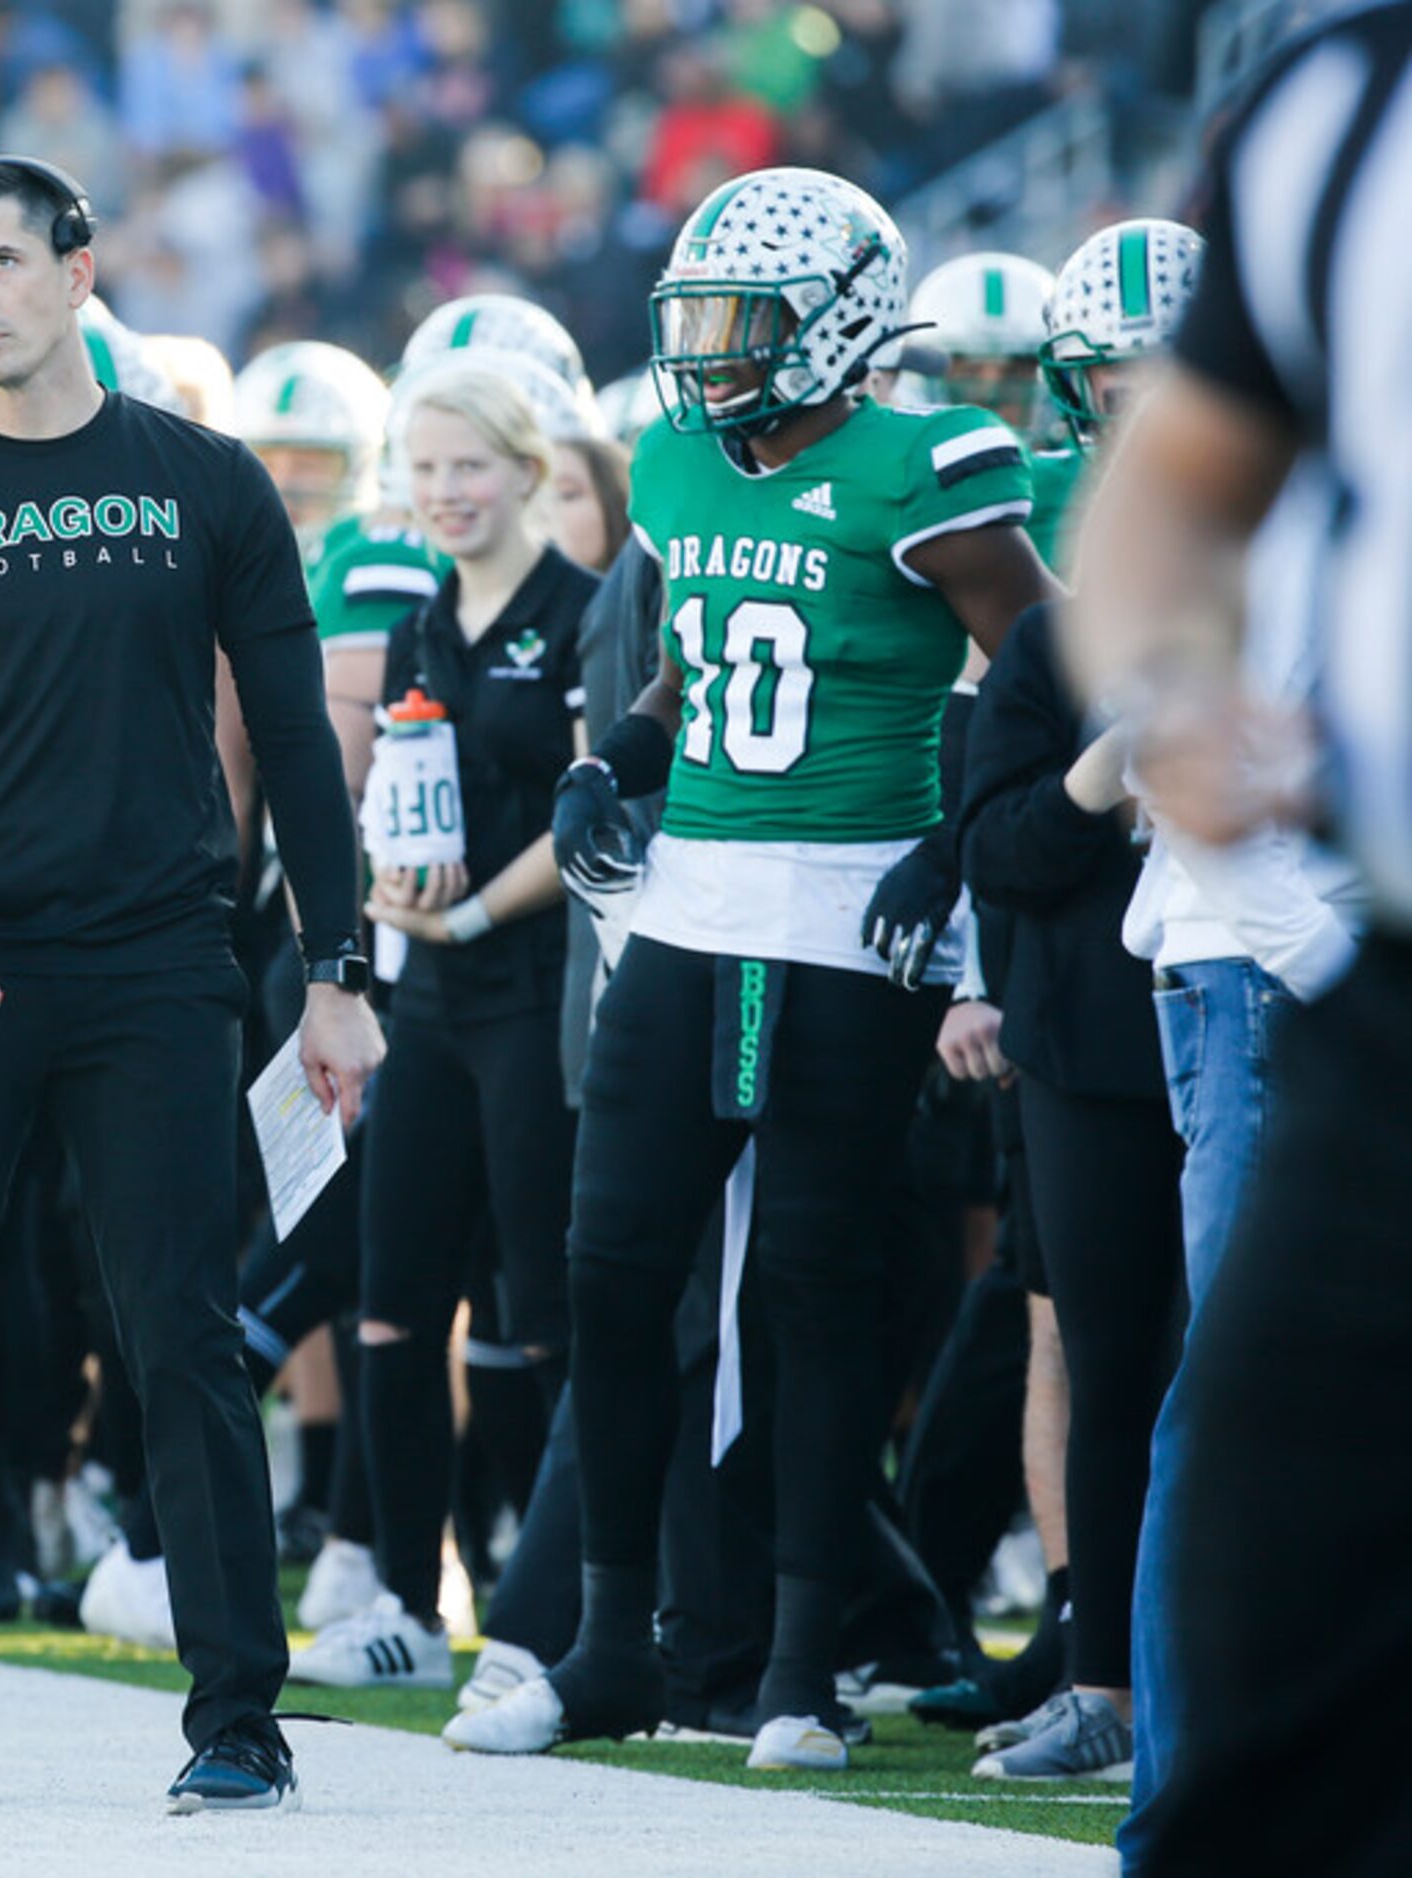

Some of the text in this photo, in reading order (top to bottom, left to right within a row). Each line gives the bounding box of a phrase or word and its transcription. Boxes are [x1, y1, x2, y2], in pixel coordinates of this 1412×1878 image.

[667, 534, 828, 591] DRAGONS
[671, 594, 817, 775] 10
[387, 778, 456, 837] OFF
[738, 960, 767, 1107] BUSS
